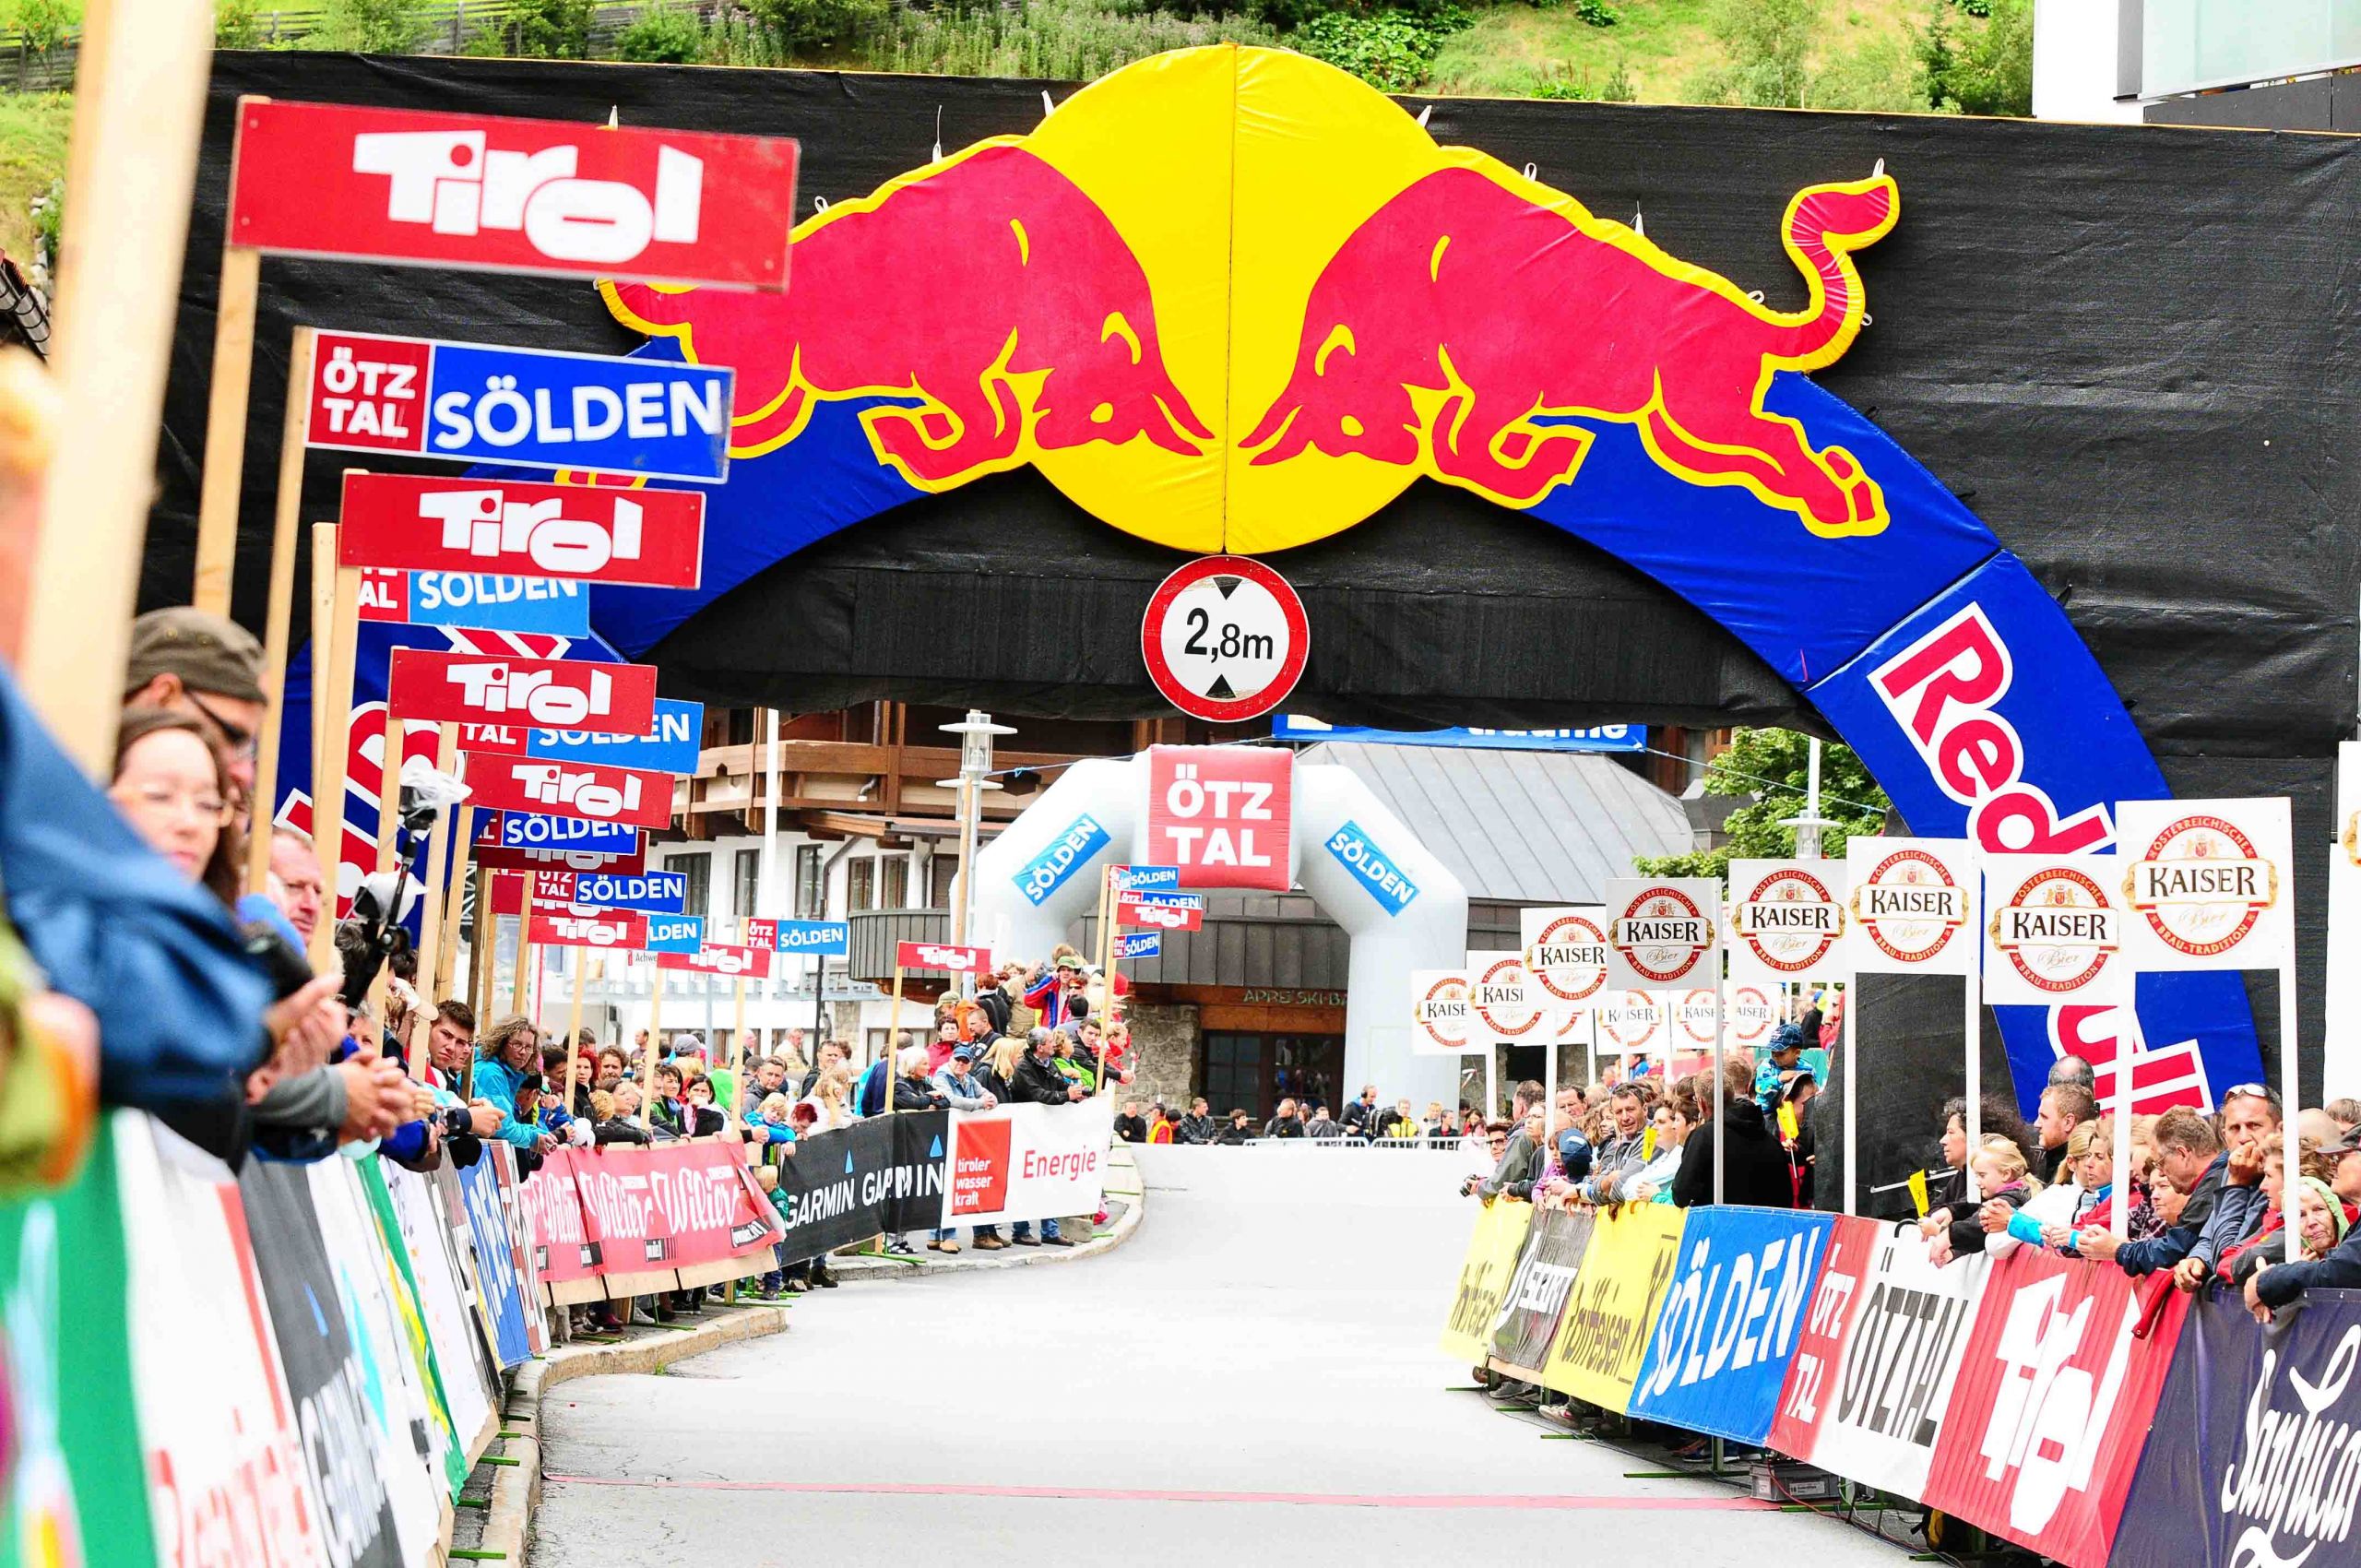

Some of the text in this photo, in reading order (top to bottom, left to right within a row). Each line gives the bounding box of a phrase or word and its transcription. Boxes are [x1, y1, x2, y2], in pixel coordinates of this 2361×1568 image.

[352, 130, 704, 264] Tirol
[322, 346, 417, 399] ÖTZ
[321, 398, 409, 438] TAL
[433, 374, 722, 449] SÖLDEN
[419, 489, 643, 572] Tirol
[358, 580, 398, 610] AL
[1184, 607, 1274, 663] 2,8m
[446, 662, 613, 725] Tirol
[462, 723, 517, 745] TAL
[1868, 601, 2115, 854] Red
[511, 764, 643, 817] Tirol
[1166, 764, 1274, 820] ÖTZ
[505, 814, 635, 843] SÖLDEN
[1024, 819, 1100, 900] SÖLDEN
[1165, 826, 1272, 867] TAL
[1131, 871, 1176, 885] SÖLDEN
[1331, 831, 1414, 906] SÖLDEN
[2148, 866, 2257, 897] KAISER
[538, 883, 570, 897] TAL
[577, 875, 683, 901] SÖLDEN
[1870, 889, 1953, 916] KAISER
[748, 921, 774, 935] ÖTZ
[1134, 906, 1189, 928] Tirol
[1751, 906, 1831, 929] KAISER
[2013, 912, 2107, 940] KAISER
[549, 918, 627, 945] Tirol
[649, 922, 697, 942] LDEN
[779, 927, 844, 948] SÖLDEN
[1125, 934, 1158, 956] SÖLDEN
[1626, 921, 1700, 942] KAISER
[916, 945, 977, 969] Tirol
[1540, 946, 1606, 966] KAISER
[1483, 987, 1524, 1004] KAIS
[1427, 1003, 1467, 1018] KAISE
[1608, 1007, 1654, 1023] KISER
[1737, 1006, 1767, 1019] AISER
[956, 1158, 992, 1173] tiroler
[1023, 1144, 1097, 1182] Energie
[955, 1174, 993, 1190] wasser
[785, 1178, 857, 1230] GARMIN
[954, 1191, 979, 1207] kraft
[1809, 1242, 1857, 1340] ÖTZ
[1638, 1225, 1822, 1408] SÖLDEN
[1837, 1246, 1970, 1448] ÖTZTAL
[1785, 1352, 1826, 1425] TAL
[1980, 1273, 2142, 1537] Tirol
